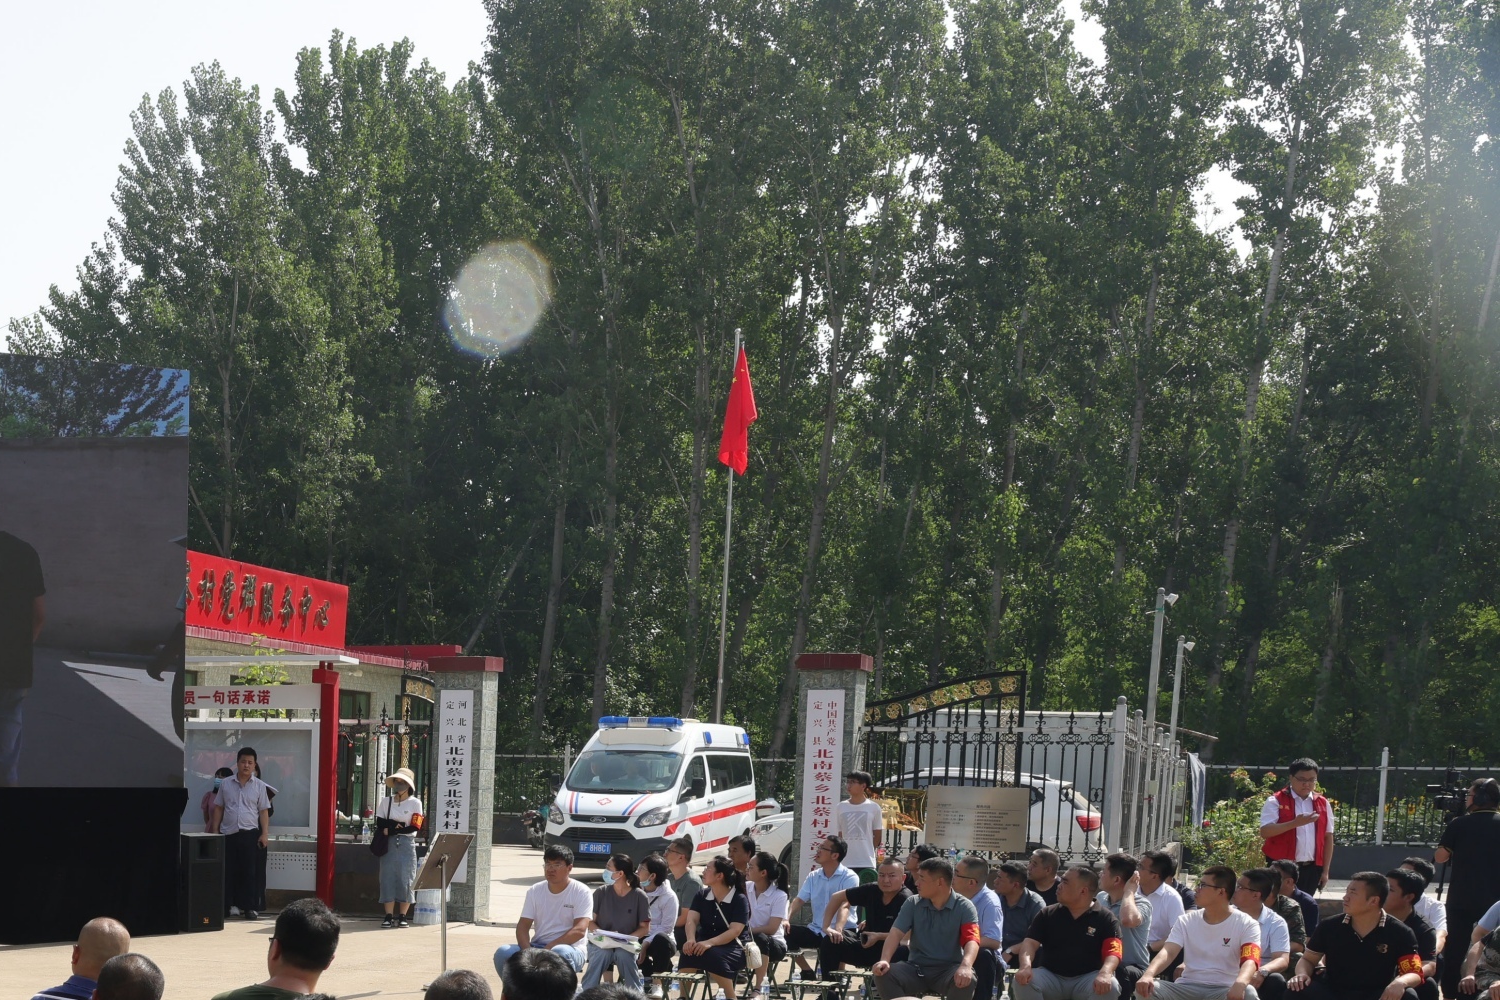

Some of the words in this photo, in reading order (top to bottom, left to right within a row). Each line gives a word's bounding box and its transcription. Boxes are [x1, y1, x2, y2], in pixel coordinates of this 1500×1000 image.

[184, 690, 271, 705] 员一句话承诺
[445, 700, 455, 744] 定兴县
[458, 700, 468, 744] 河北省
[813, 700, 823, 745] 定兴县
[827, 700, 838, 746] 中国共产党
